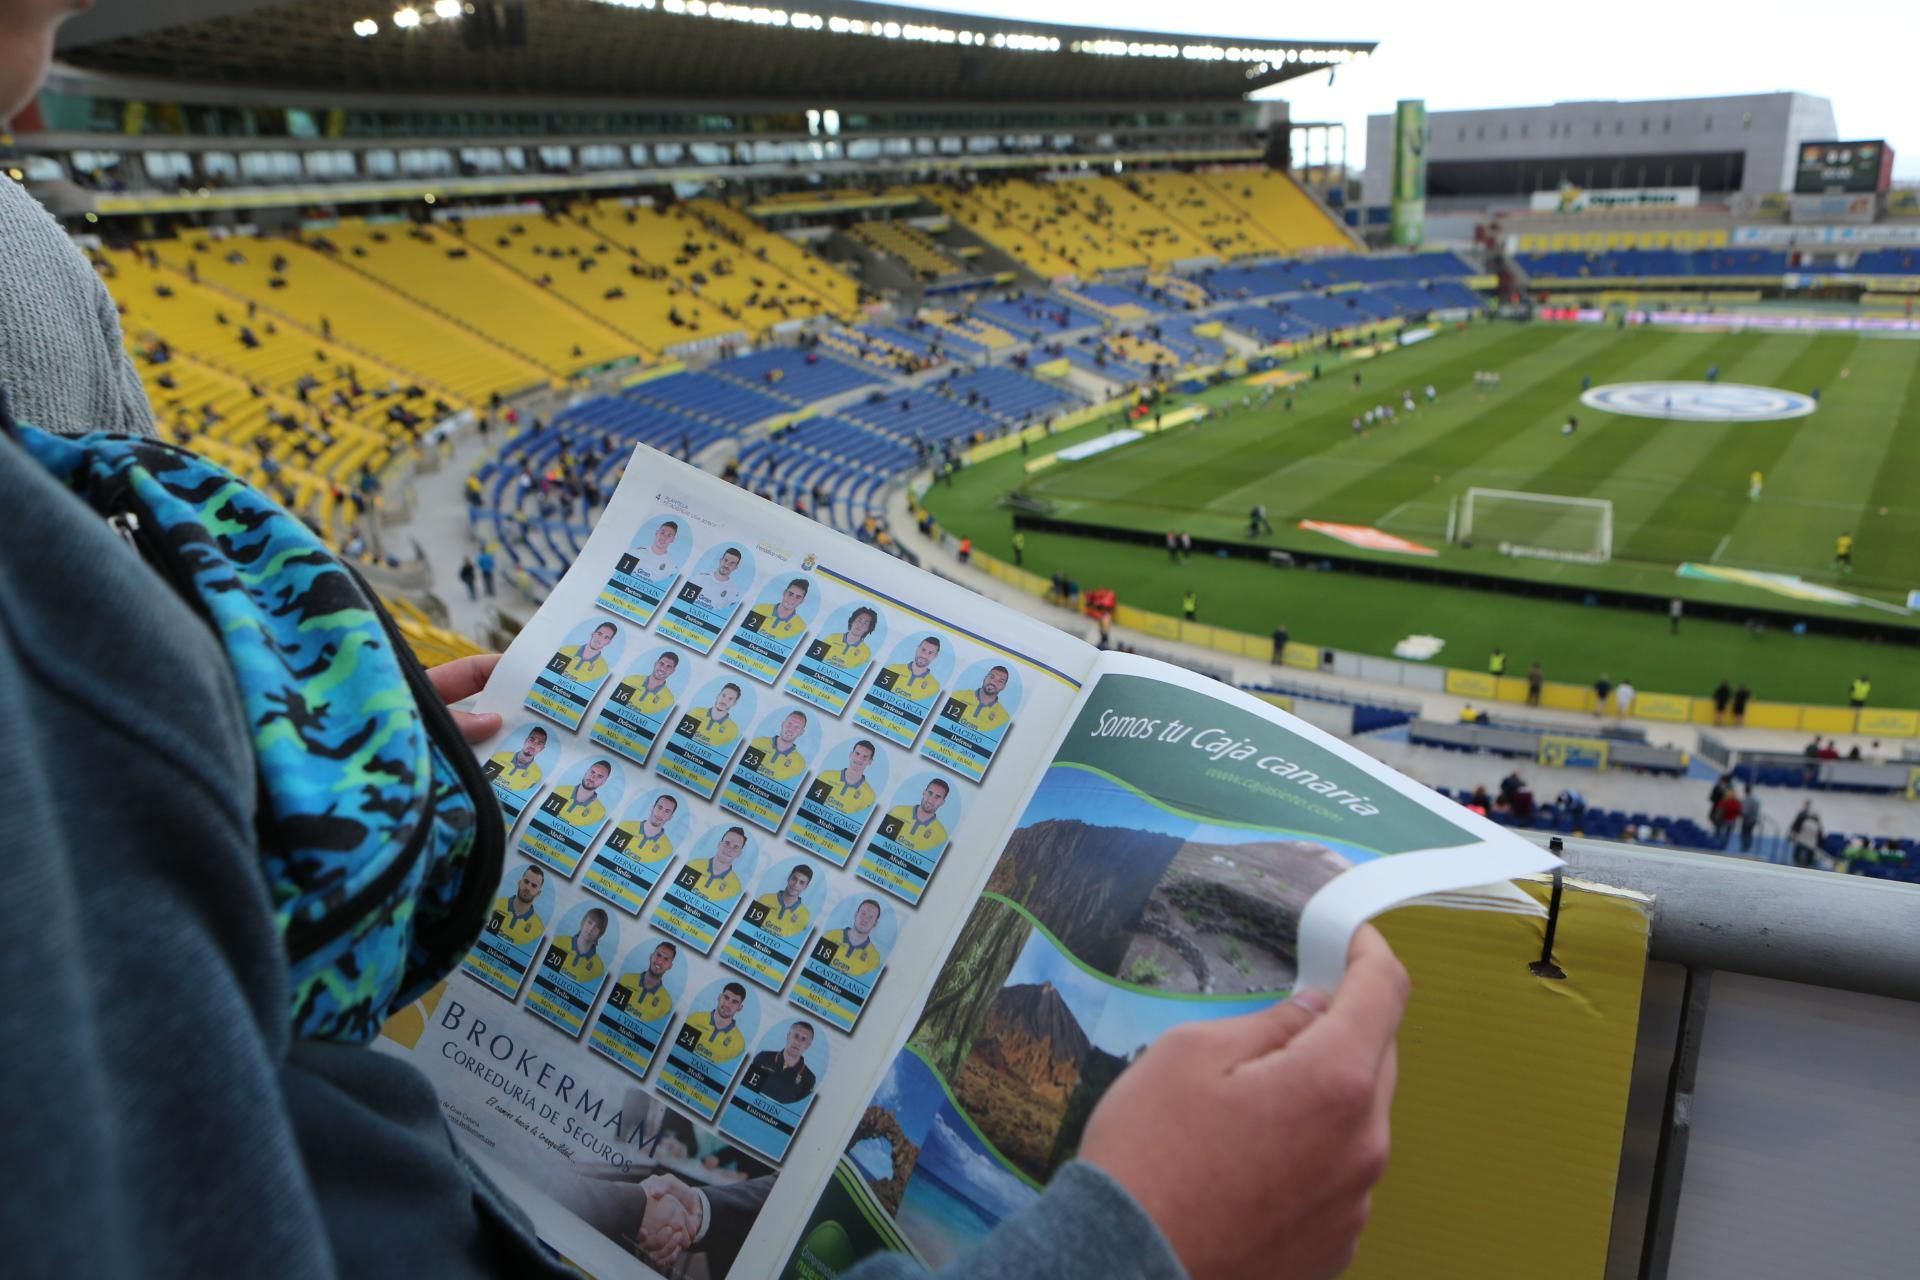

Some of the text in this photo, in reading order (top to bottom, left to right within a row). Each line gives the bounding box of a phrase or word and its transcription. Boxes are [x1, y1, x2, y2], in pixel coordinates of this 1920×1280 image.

[623, 560, 630, 569] 1
[683, 588, 696, 600] 13
[748, 617, 757, 628] 2
[813, 646, 822, 656] 3
[552, 658, 566, 671] 17
[881, 675, 891, 685] 5
[615, 689, 630, 702] 16
[872, 689, 896, 704] DAVID
[947, 704, 961, 718] 12
[680, 720, 696, 734] 22
[949, 724, 983, 744] MACEDO
[685, 741, 713, 759] HELDER
[744, 753, 760, 767] 23
[1091, 709, 1380, 817] Somos tu Caja canaria
[486, 766, 495, 777] 7
[744, 771, 791, 799] CASTELLANO
[813, 787, 824, 799] 4
[547, 798, 560, 811] 11
[802, 800, 834, 821] VICENTE
[551, 820, 575, 837] MOMO
[817, 819, 835, 832] Medio
[885, 823, 895, 834] 6
[549, 830, 566, 842] Medio
[612, 834, 626, 848] 14
[882, 841, 923, 866] MONTORO
[889, 855, 908, 868] Medio
[614, 866, 632, 880] Medio
[680, 872, 695, 886] 15
[674, 888, 721, 918] ROQUE MESA
[684, 904, 702, 918] Medio
[749, 907, 764, 922] 19
[754, 931, 781, 949] MATEO
[753, 942, 772, 955] Medio
[817, 945, 833, 960] 18
[547, 952, 562, 967] 20
[833, 958, 851, 972] Gran
[815, 964, 865, 996] CASTELLANO
[553, 987, 571, 1001] Medio
[823, 981, 842, 994] Medio
[611, 990, 627, 1006] 21
[623, 1018, 644, 1034] VIERA
[680, 1031, 696, 1046] 24
[690, 1058, 710, 1074] TANA
[441, 1001, 664, 1159] BROKERMAM
[749, 1073, 761, 1087] E
[442, 1041, 536, 1113] CORREDURÍA
[541, 1103, 559, 1125] DE
[562, 1116, 633, 1174] SEGUROS
[486, 1096, 495, 1107] El
[530, 1125, 539, 1136] la
[746, 1105, 779, 1127] Entrenador
